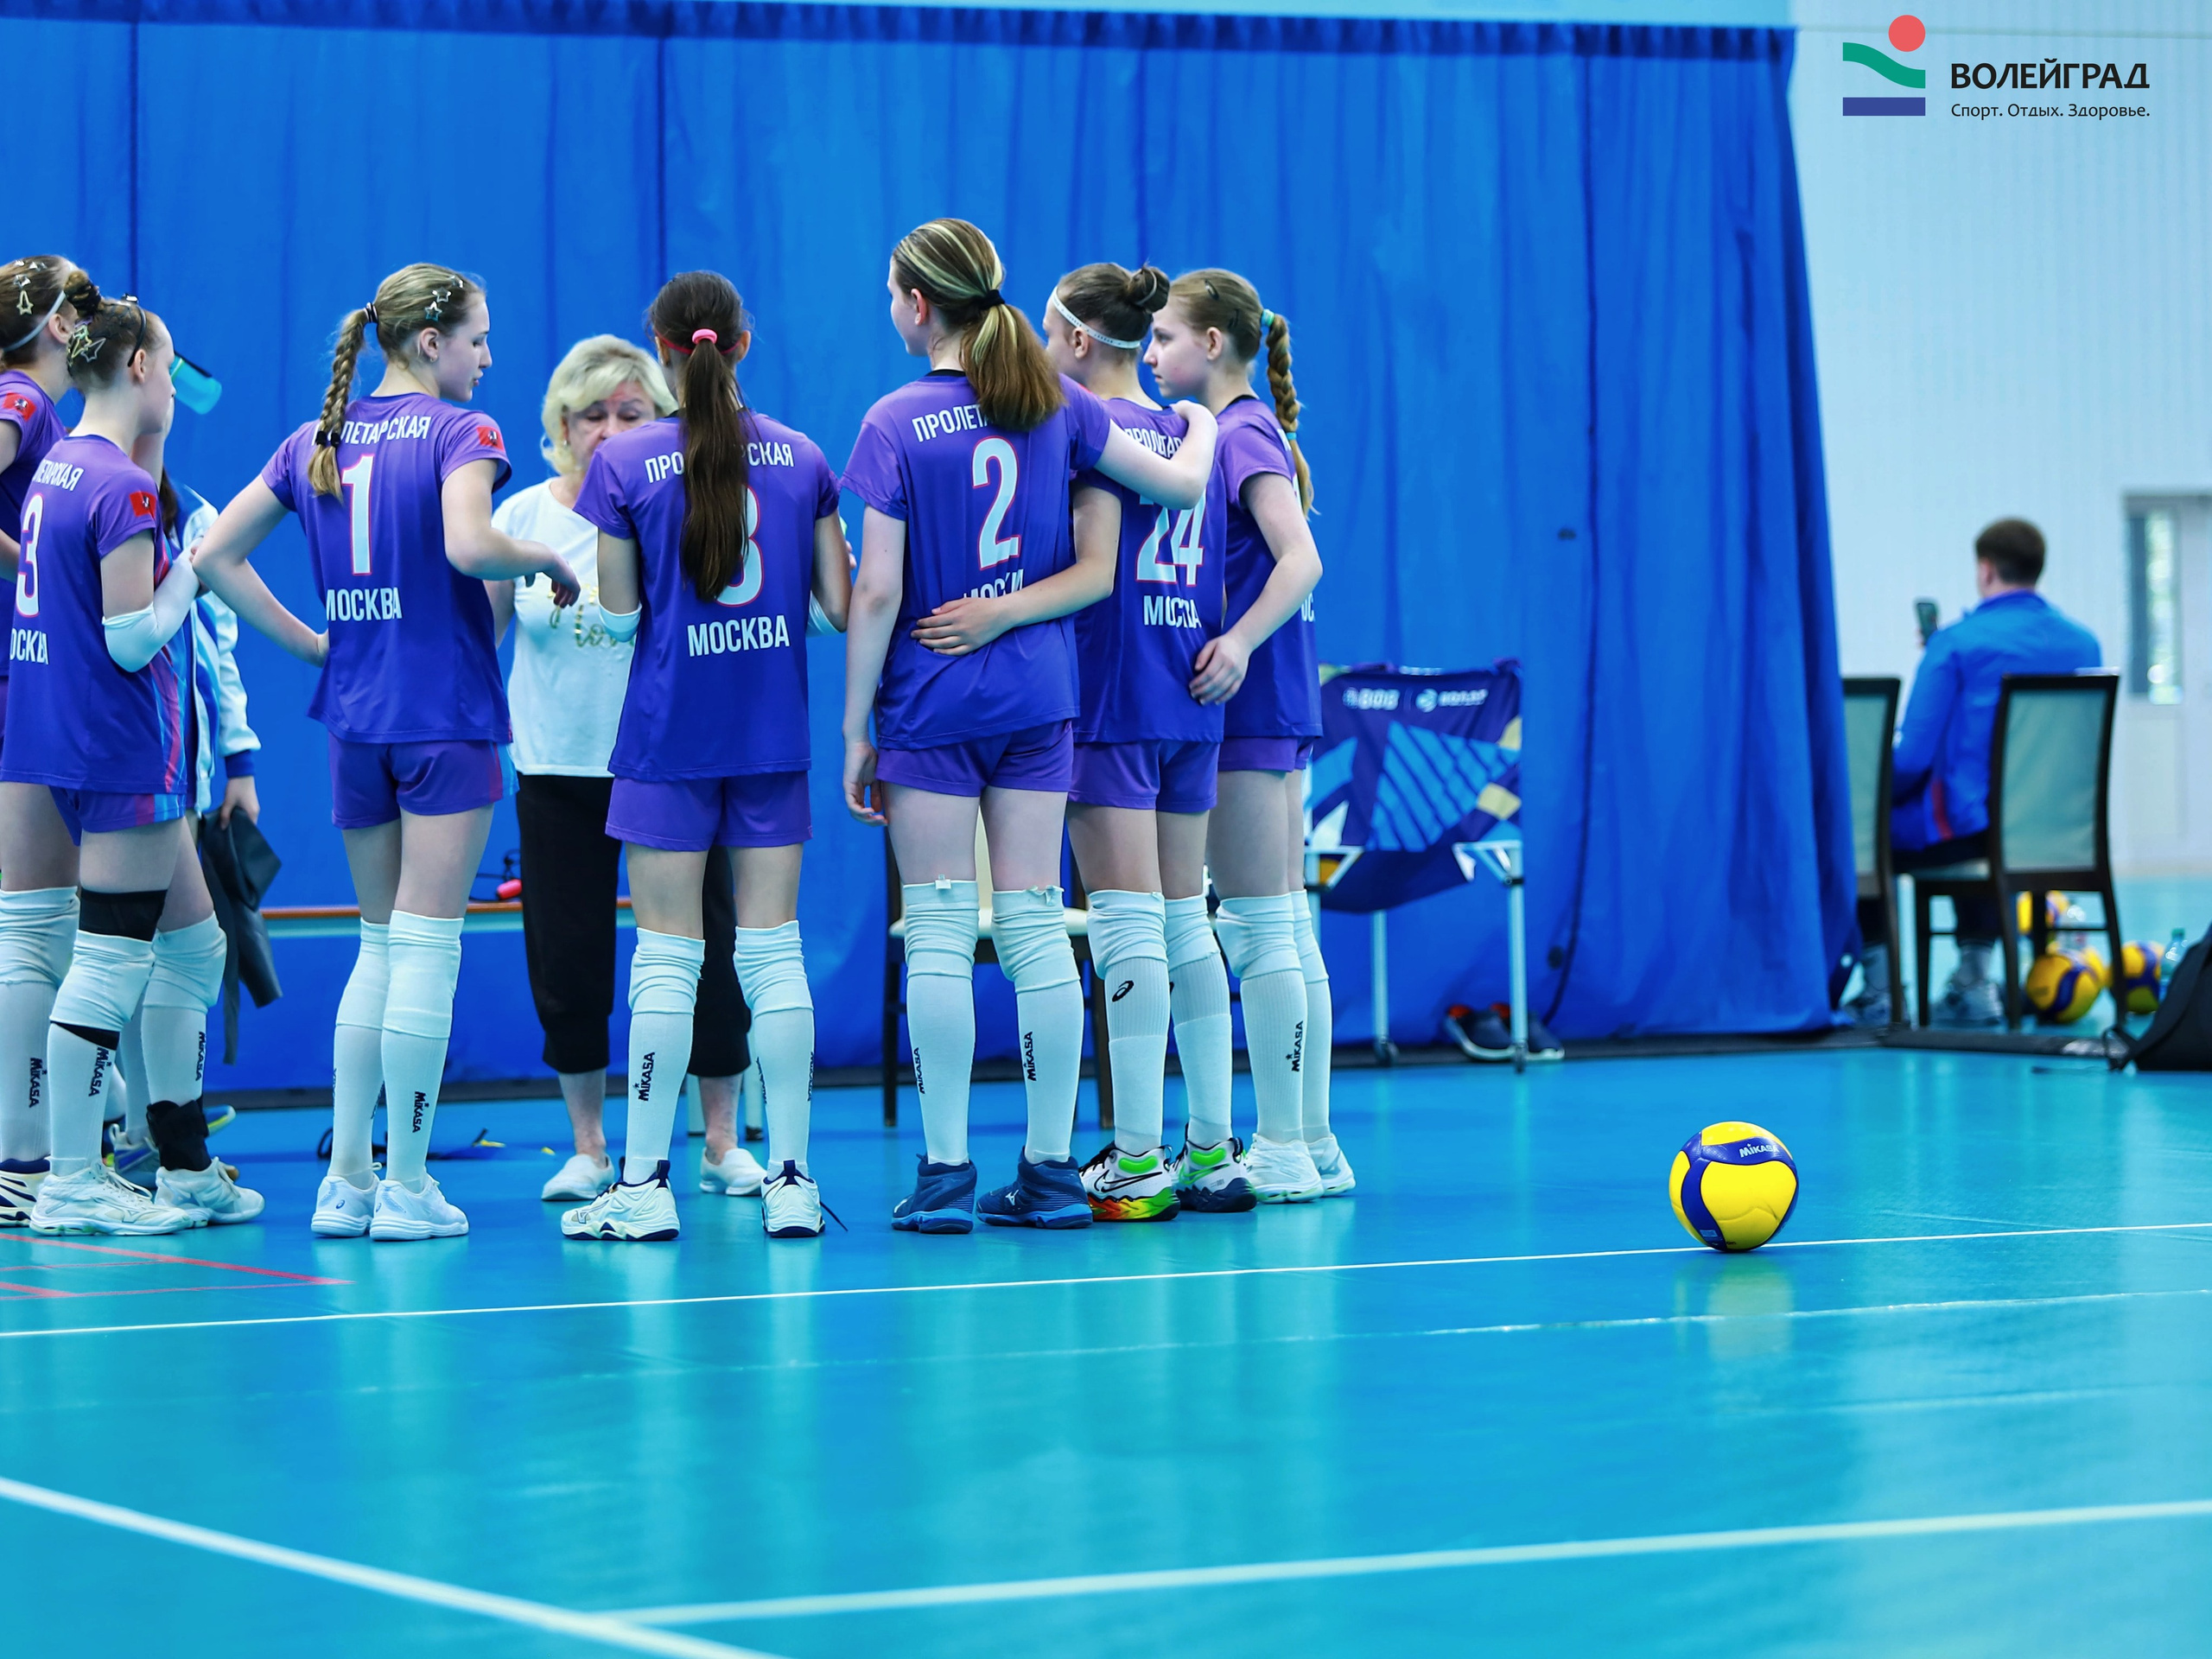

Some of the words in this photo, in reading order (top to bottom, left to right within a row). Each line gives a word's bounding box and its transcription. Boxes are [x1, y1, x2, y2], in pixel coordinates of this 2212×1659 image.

[311, 415, 432, 446] ЛЕТАРСКАЯ
[912, 404, 988, 442] ПРОЛЕТ
[645, 441, 795, 484] ПРОСКАЯ
[341, 454, 375, 576] 1
[972, 435, 1021, 570] 2
[1135, 486, 1205, 587] 24
[16, 493, 44, 618] 3
[687, 614, 791, 658] МОСКВА
